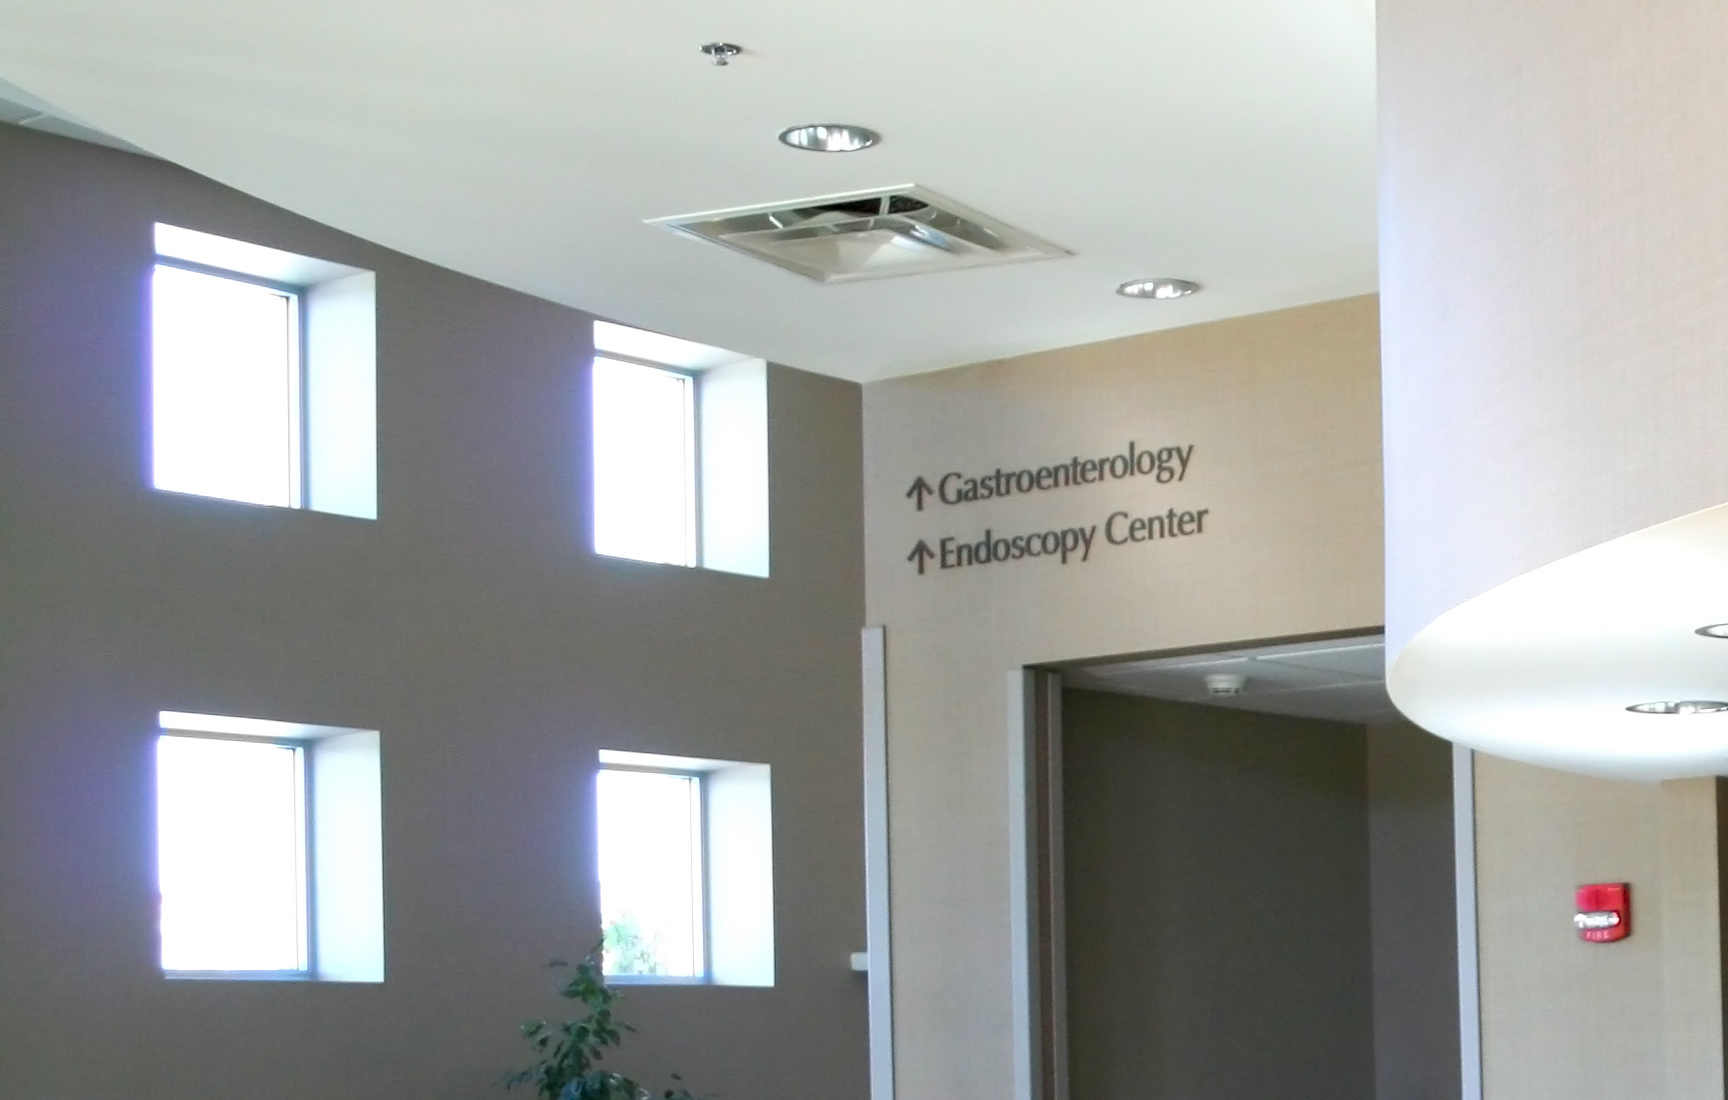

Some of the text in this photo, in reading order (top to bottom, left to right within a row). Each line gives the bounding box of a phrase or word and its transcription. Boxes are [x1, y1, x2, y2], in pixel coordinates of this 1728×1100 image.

[938, 440, 1194, 505] Gastroenterology
[939, 507, 1209, 570] Endoscopy Center
